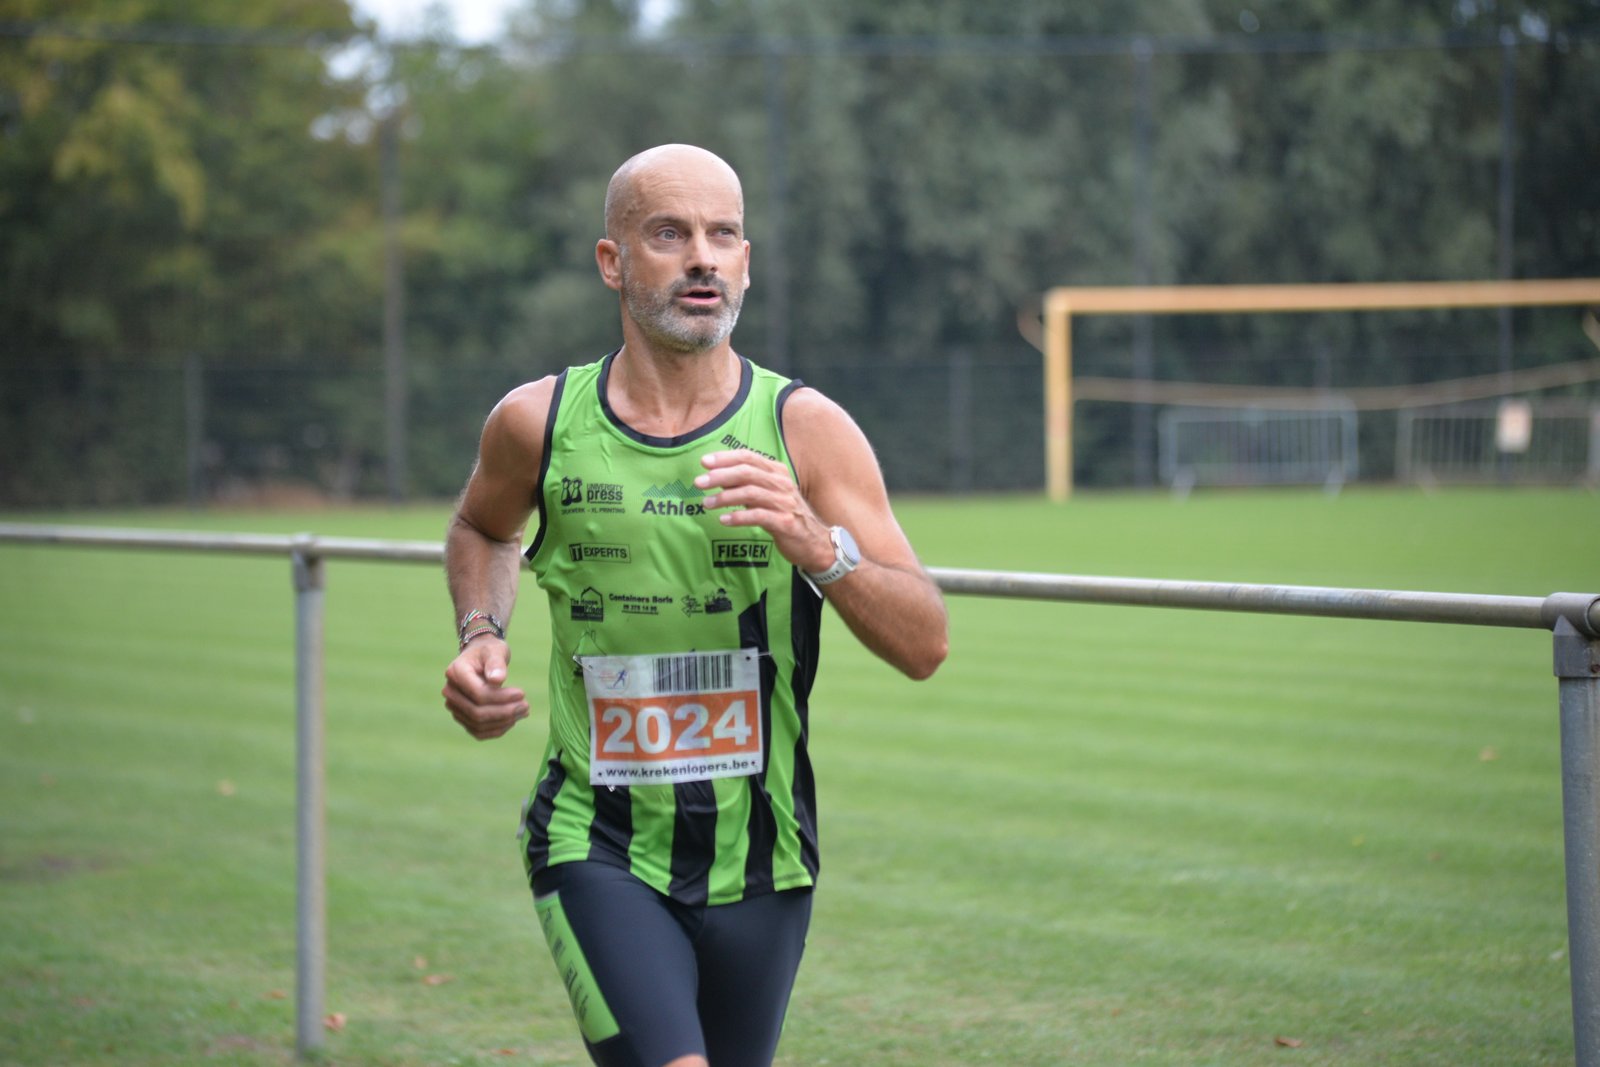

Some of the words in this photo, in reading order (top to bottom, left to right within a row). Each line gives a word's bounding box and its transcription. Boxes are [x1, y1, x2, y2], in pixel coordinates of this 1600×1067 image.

[587, 489, 623, 504] press
[642, 499, 706, 516] Athlex
[583, 547, 628, 559] EXPERTS
[717, 544, 768, 558] FIESIEK
[602, 700, 752, 754] 2024
[606, 760, 748, 777] www.krekenlopers.be
